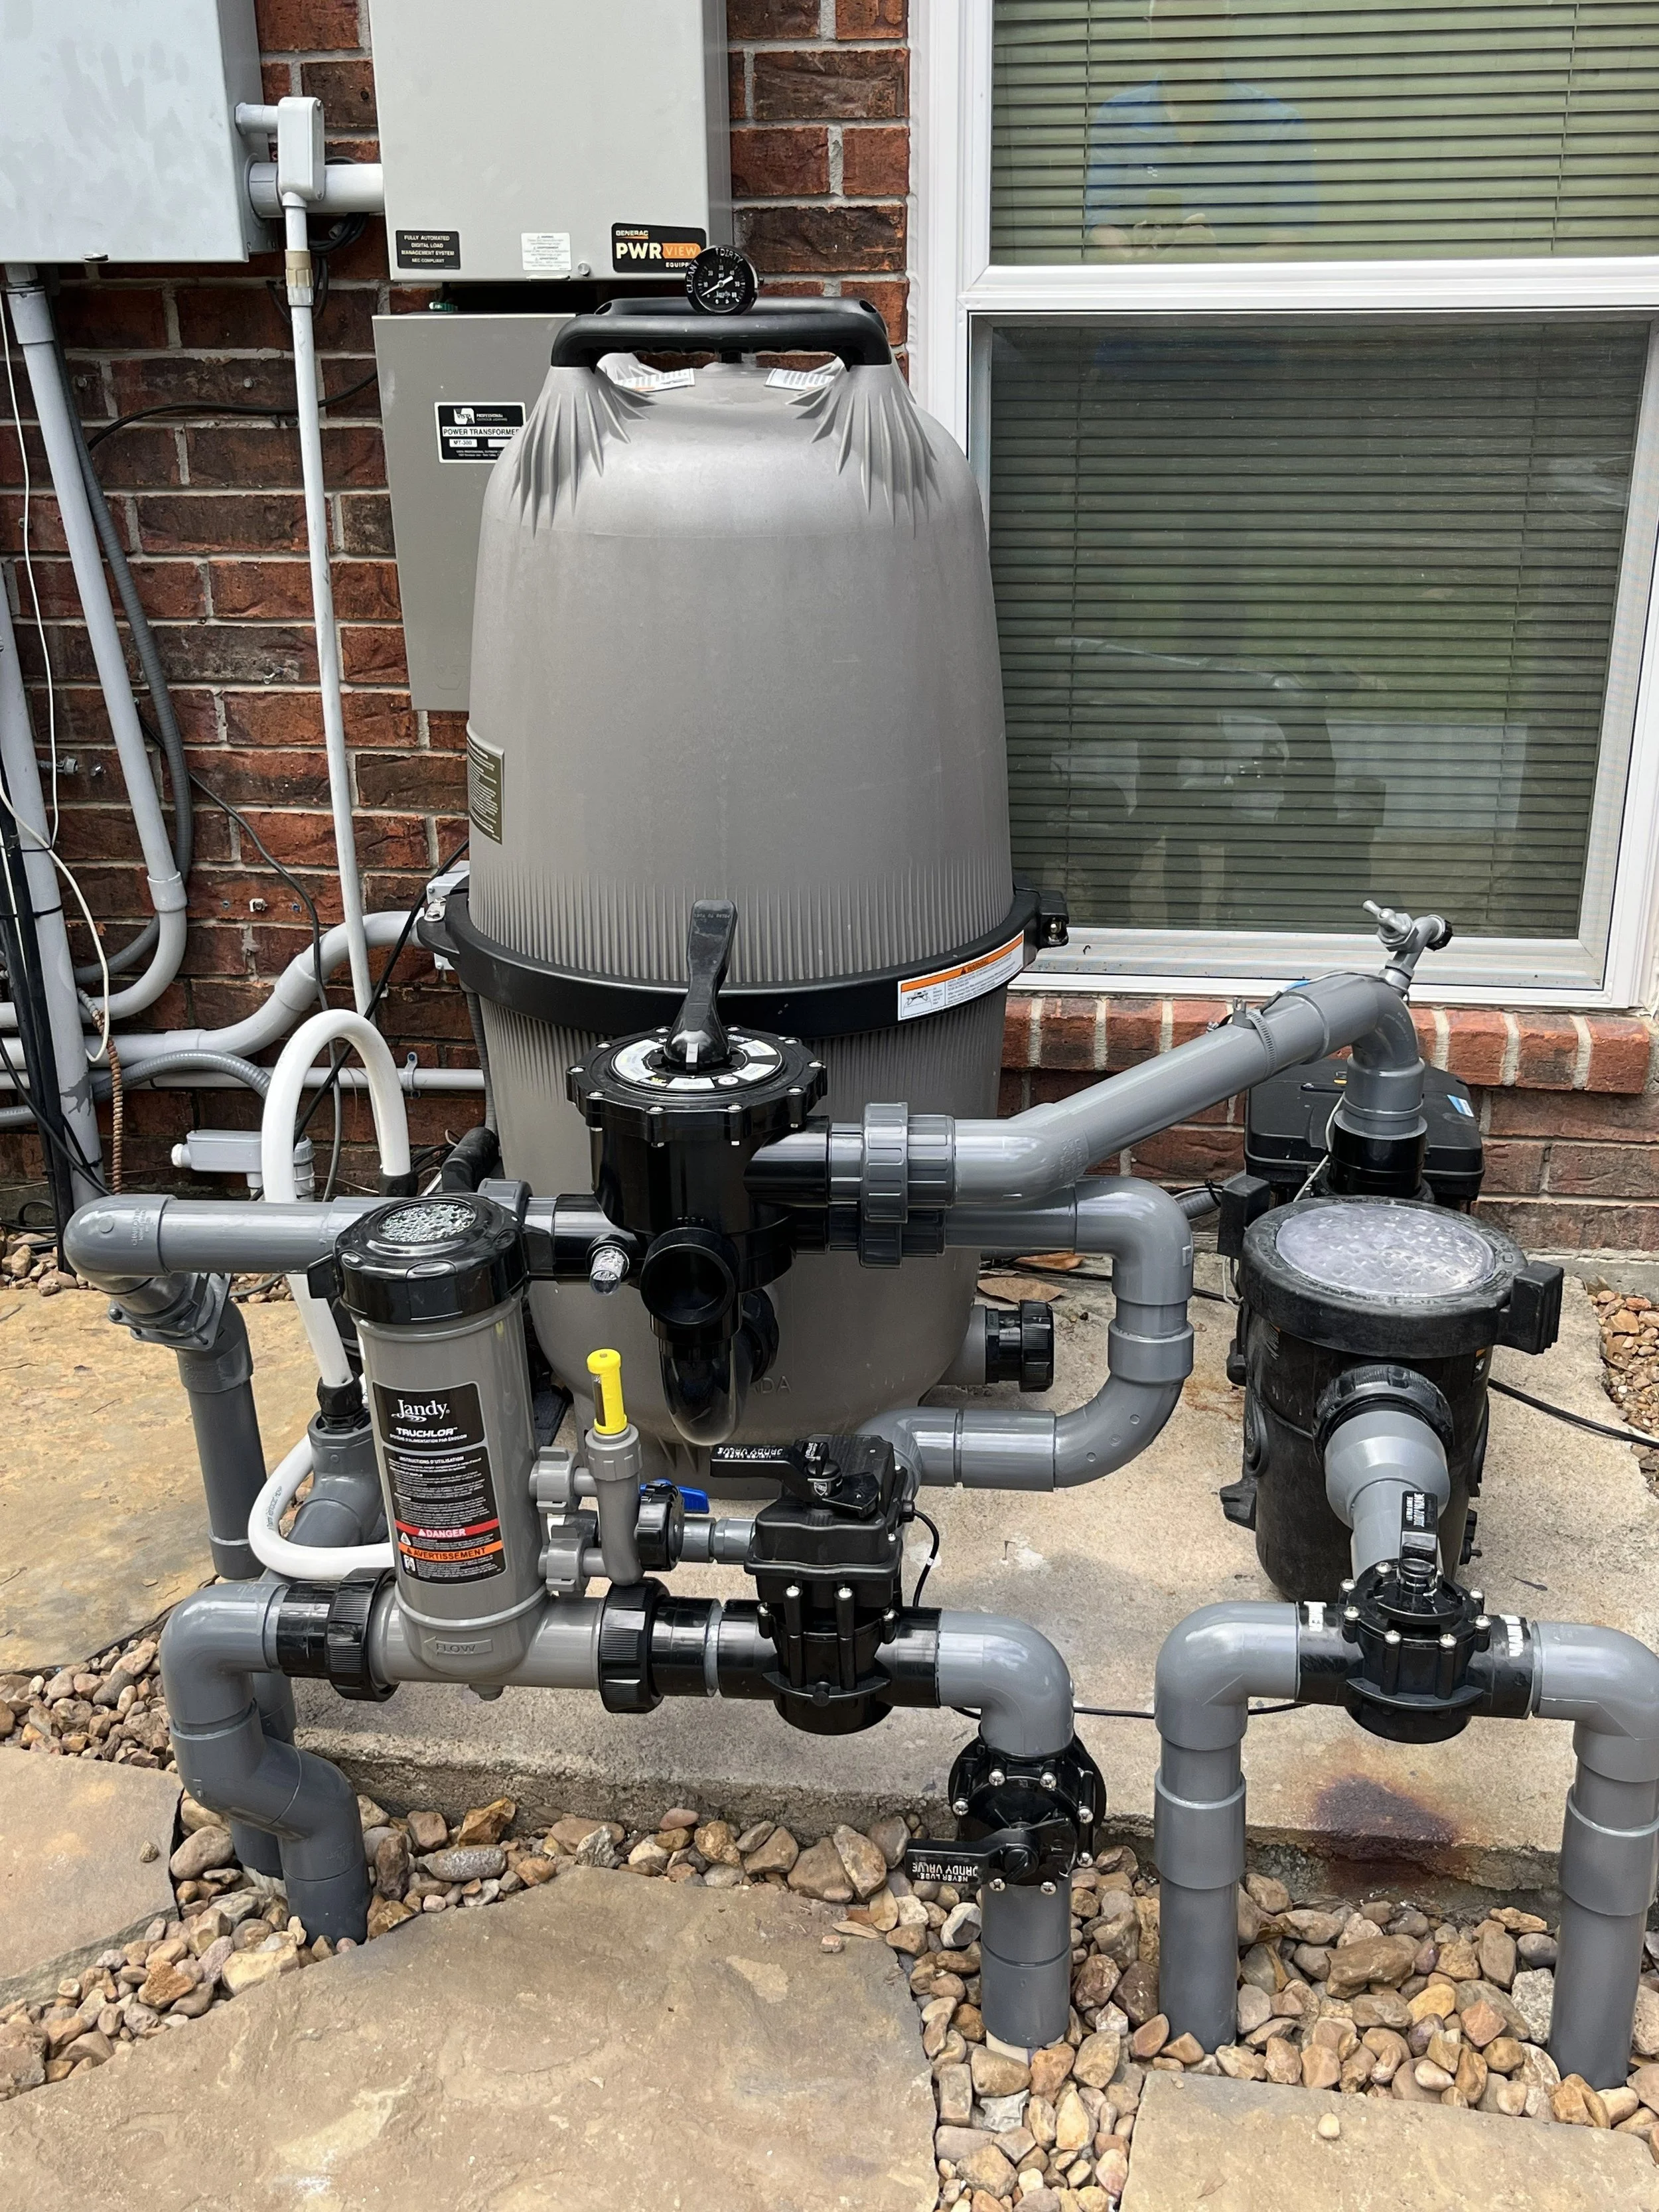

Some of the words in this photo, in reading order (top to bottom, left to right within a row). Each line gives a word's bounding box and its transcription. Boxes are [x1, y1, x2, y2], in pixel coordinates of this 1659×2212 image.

[720, 248, 743, 263] DIRTY
[686, 263, 698, 293] CLEAN
[425, 1528, 467, 1538] DANGER
[413, 1547, 486, 1560] AVERTISSEMENT
[435, 1643, 476, 1654] FLOW
[912, 1861, 943, 1874] VALVE
[945, 1865, 979, 1877] JANDY
